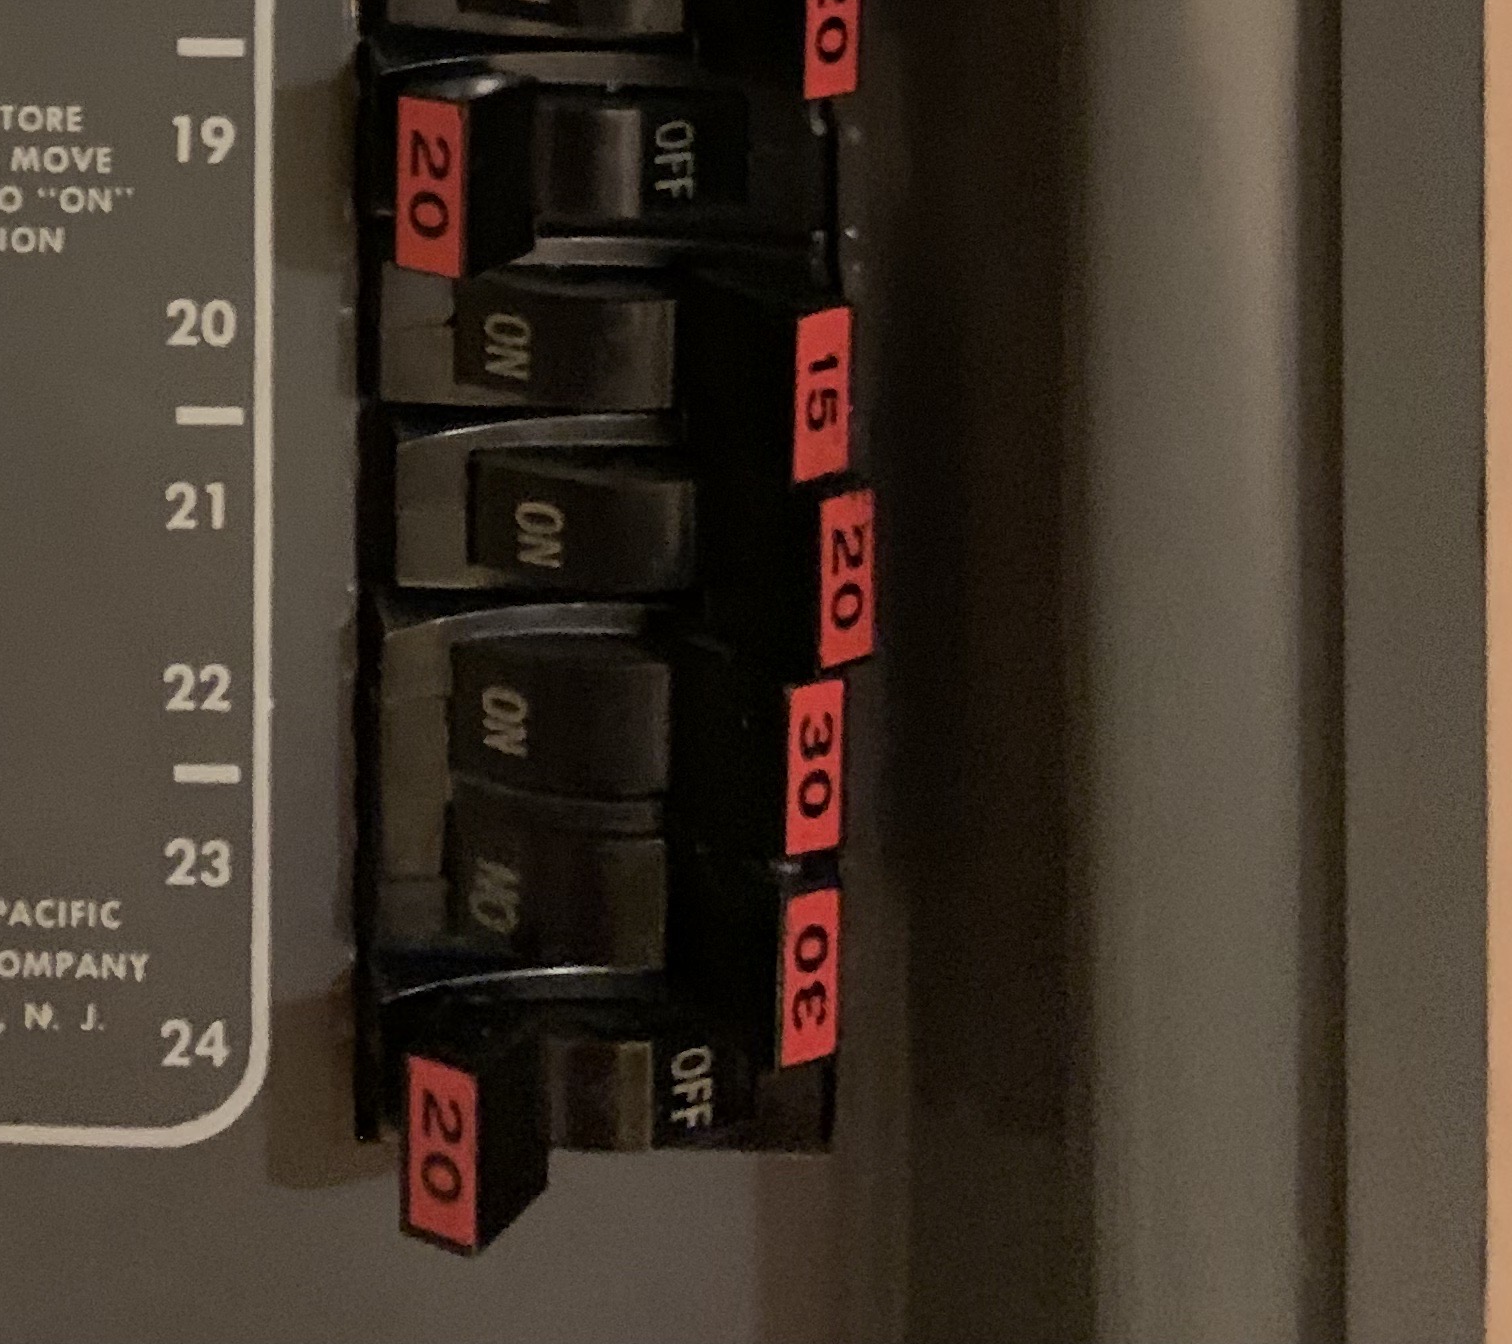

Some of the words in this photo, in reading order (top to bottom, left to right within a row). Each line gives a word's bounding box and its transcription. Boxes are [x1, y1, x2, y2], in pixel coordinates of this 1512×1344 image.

[10, 147, 113, 174] MOVE
[172, 115, 236, 164] 19
[654, 119, 695, 199] OFF
[410, 129, 450, 239] 20
[166, 298, 236, 347] 20
[484, 312, 531, 380] ON
[806, 353, 838, 432] 15
[165, 482, 225, 530] 21
[515, 501, 564, 569] ON
[831, 527, 864, 629] 20
[162, 664, 231, 712] 22
[482, 688, 529, 757] ON
[798, 712, 833, 818] 30
[164, 838, 231, 886] 23
[468, 856, 521, 933] ON
[793, 924, 829, 1030] 30
[160, 1019, 230, 1067] 24
[669, 1045, 713, 1129] OFF
[420, 1088, 462, 1201] 20
